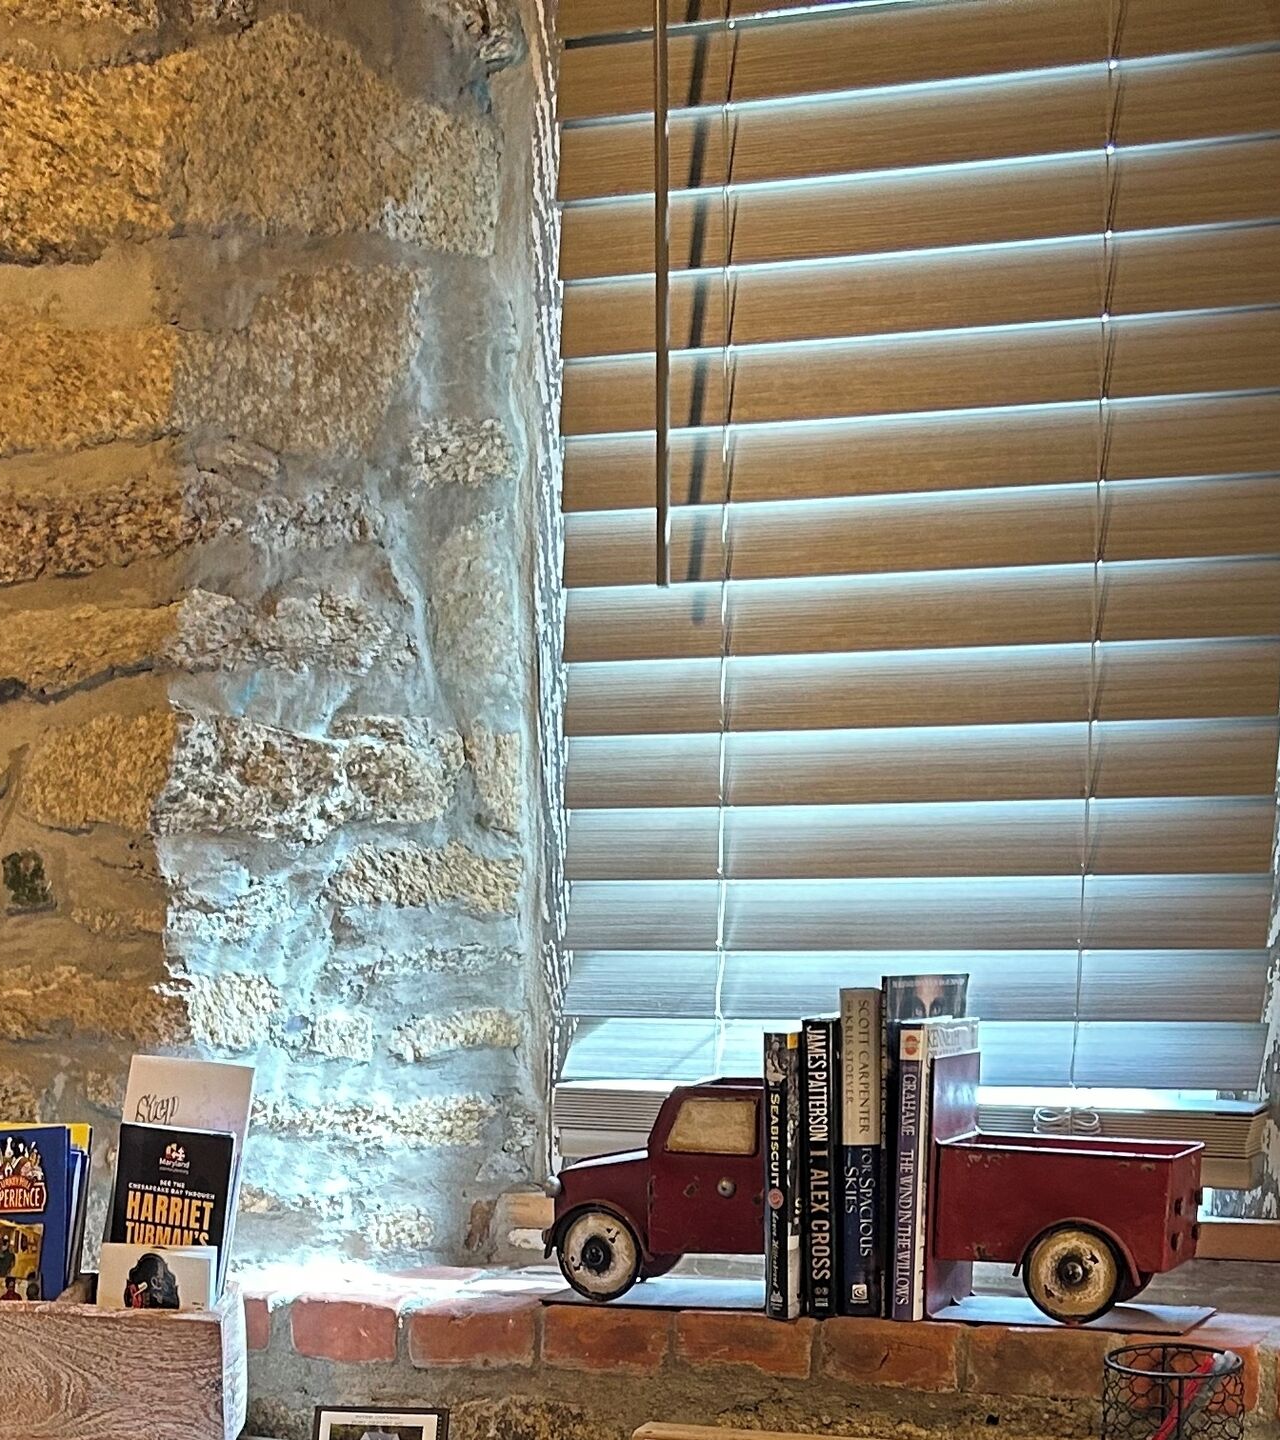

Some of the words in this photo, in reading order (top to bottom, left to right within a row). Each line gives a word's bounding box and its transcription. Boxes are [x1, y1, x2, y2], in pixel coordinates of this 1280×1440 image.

[845, 1015, 854, 1045] KRIS
[859, 1000, 870, 1045] SCOTT
[807, 1025, 826, 1069] JAMES
[807, 1071, 829, 1142] PATTERSON
[859, 1050, 871, 1134] CARPENTER
[902, 1073, 917, 1136] GRAHAME
[770, 1093, 781, 1188] SEABISCUIT
[899, 1149, 914, 1173] THE
[126, 1191, 214, 1231] HARRIET
[809, 1168, 830, 1213] ALEX
[844, 1166, 858, 1214] SKIES
[898, 1174, 913, 1210] WIND
[858, 1175, 874, 1257] SPACIOUS
[897, 1224, 911, 1249] THE
[898, 1210, 912, 1223] IN
[811, 1219, 831, 1280] CROSS
[895, 1250, 910, 1305] WILLOWS
